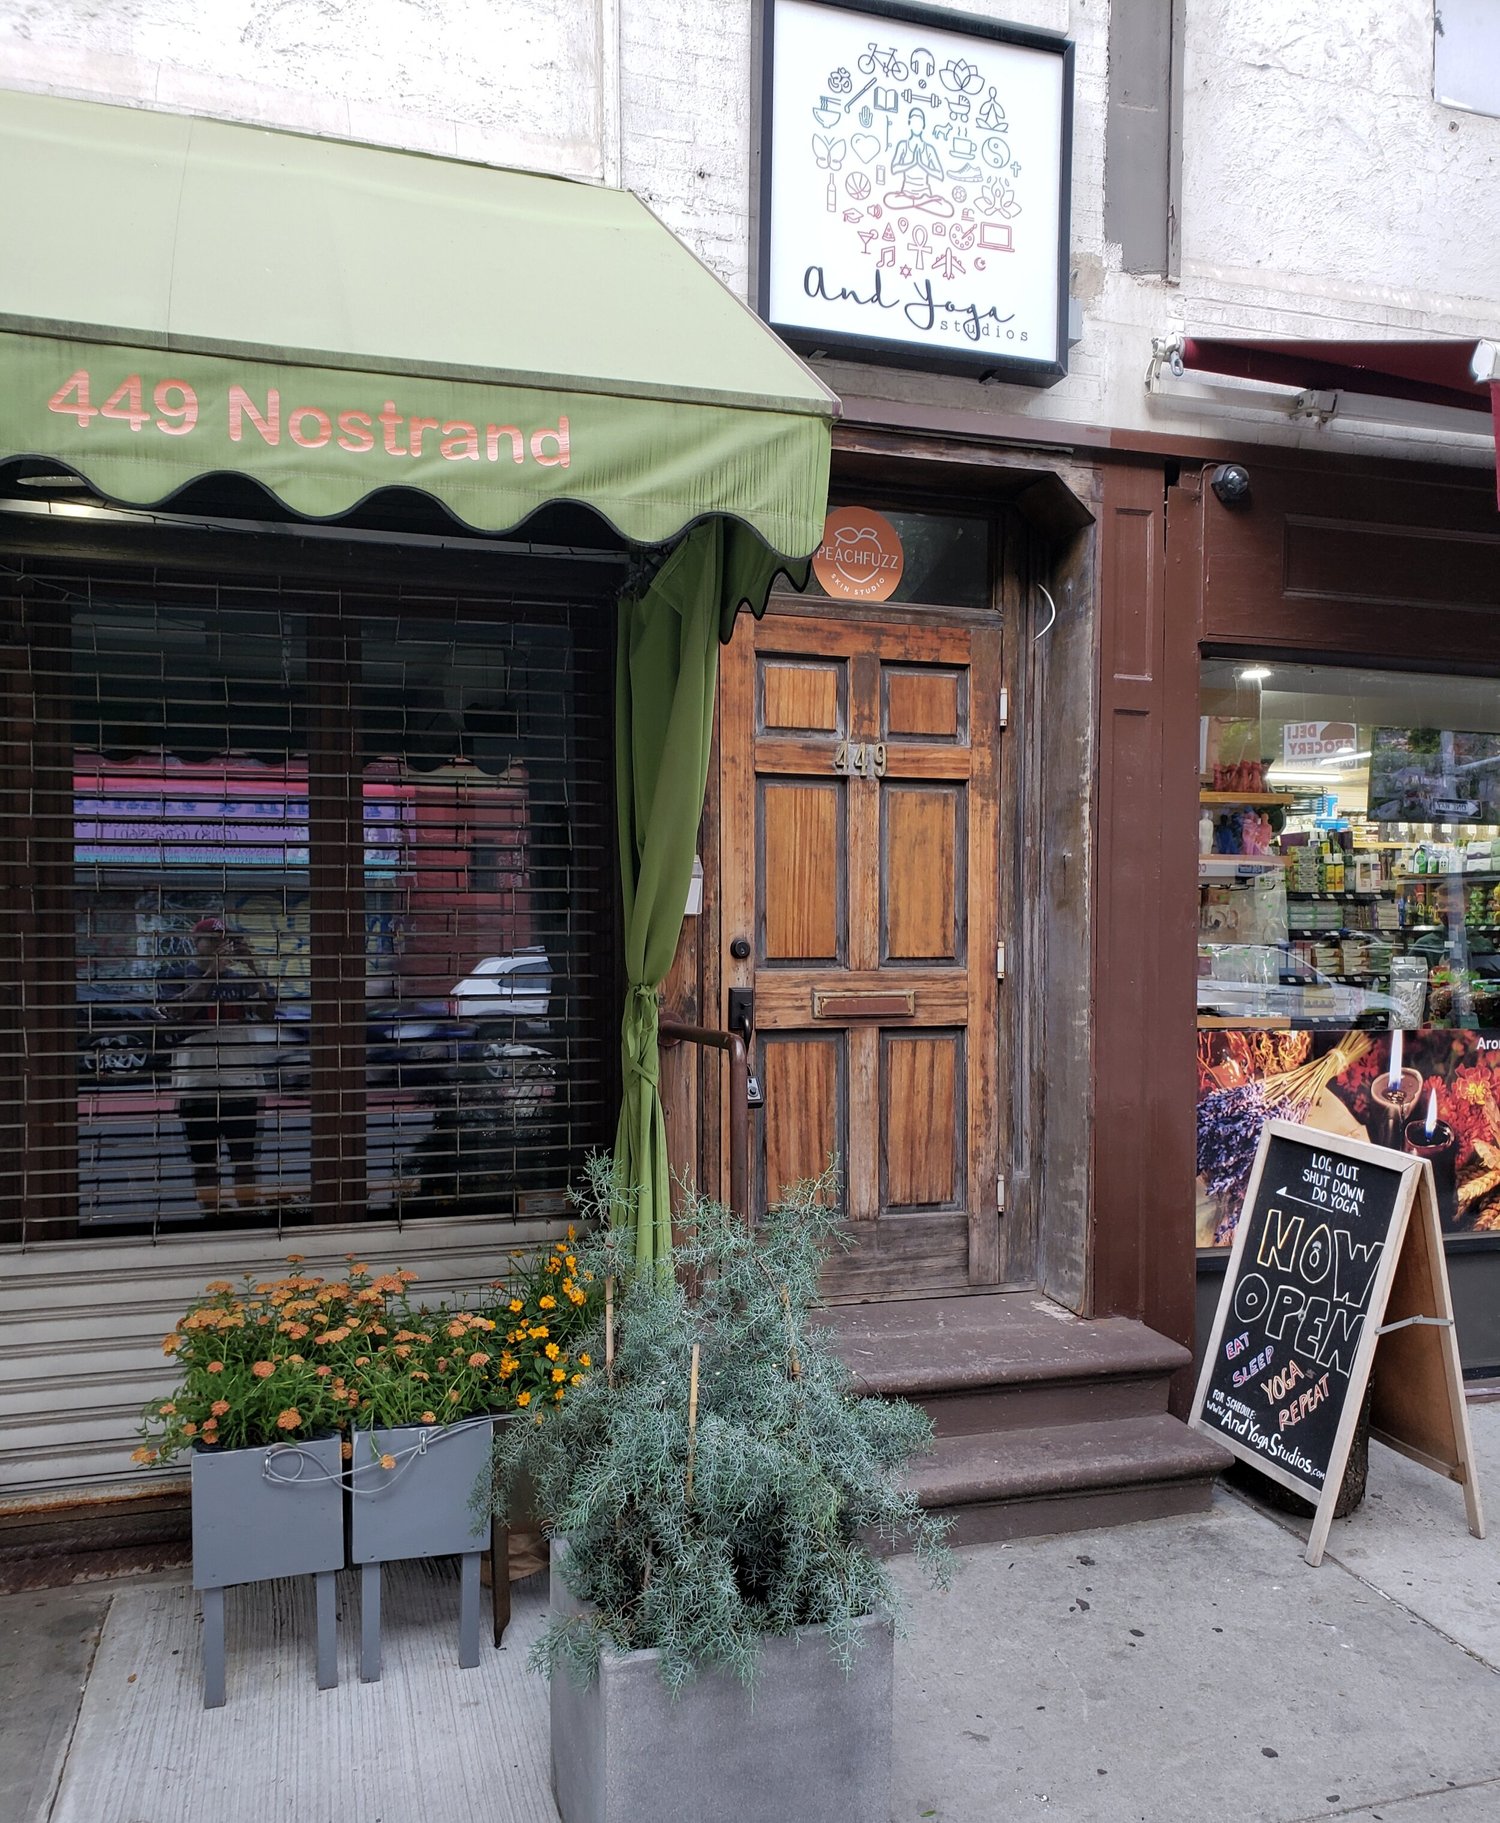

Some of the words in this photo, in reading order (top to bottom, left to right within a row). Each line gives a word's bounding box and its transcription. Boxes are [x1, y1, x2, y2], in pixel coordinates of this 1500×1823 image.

[904, 278, 1016, 342] Yoga
[939, 318, 1029, 343] studios
[47, 369, 200, 436] 449
[228, 384, 571, 469] Nostrand
[816, 544, 899, 570] PEACHFUZZ
[831, 573, 850, 593] SKIN
[853, 577, 885, 596] STUDIO
[833, 740, 888, 779] 449
[1311, 1152, 1333, 1173] LOG
[1335, 1162, 1360, 1182] OUT.
[1302, 1168, 1331, 1188] SHUT
[1332, 1178, 1365, 1204] DOWN.
[1311, 1186, 1328, 1203] DO
[1330, 1193, 1362, 1217] YOGA.
[1257, 1208, 1386, 1308] NOW
[1234, 1273, 1367, 1378] OPEN
[1225, 1331, 1250, 1361] EAT
[1232, 1345, 1274, 1388] SLEEP
[1260, 1359, 1305, 1406] YOGA
[1212, 1388, 1225, 1404] FOR
[1278, 1372, 1330, 1432] REPEAT
